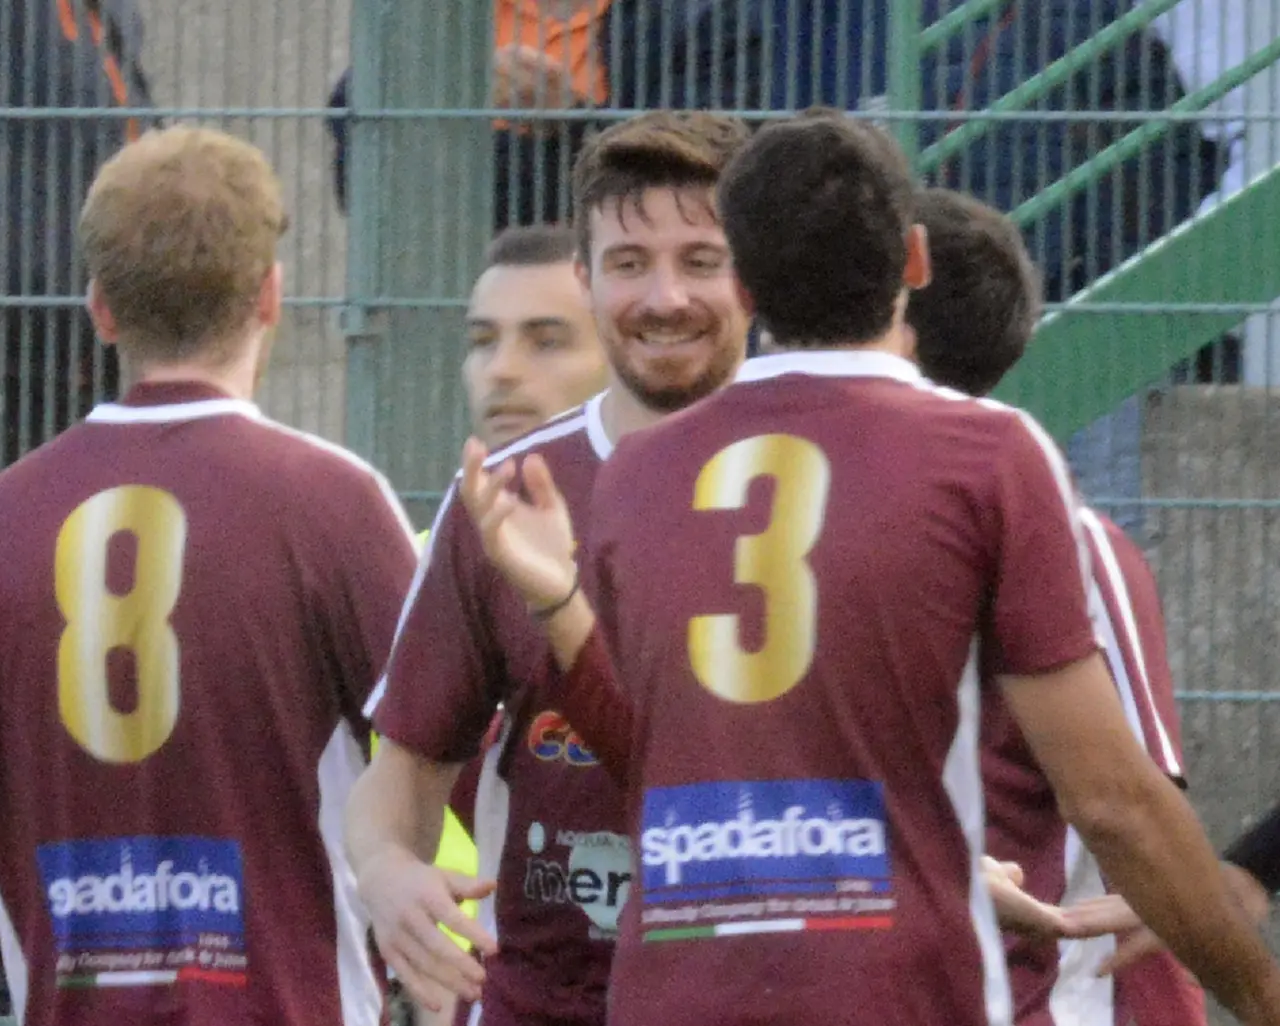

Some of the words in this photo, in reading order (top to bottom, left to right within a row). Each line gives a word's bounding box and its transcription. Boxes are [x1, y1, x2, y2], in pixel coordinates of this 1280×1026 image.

[55, 484, 188, 763] 8
[686, 433, 831, 703] 3
[641, 792, 886, 886] spadafora
